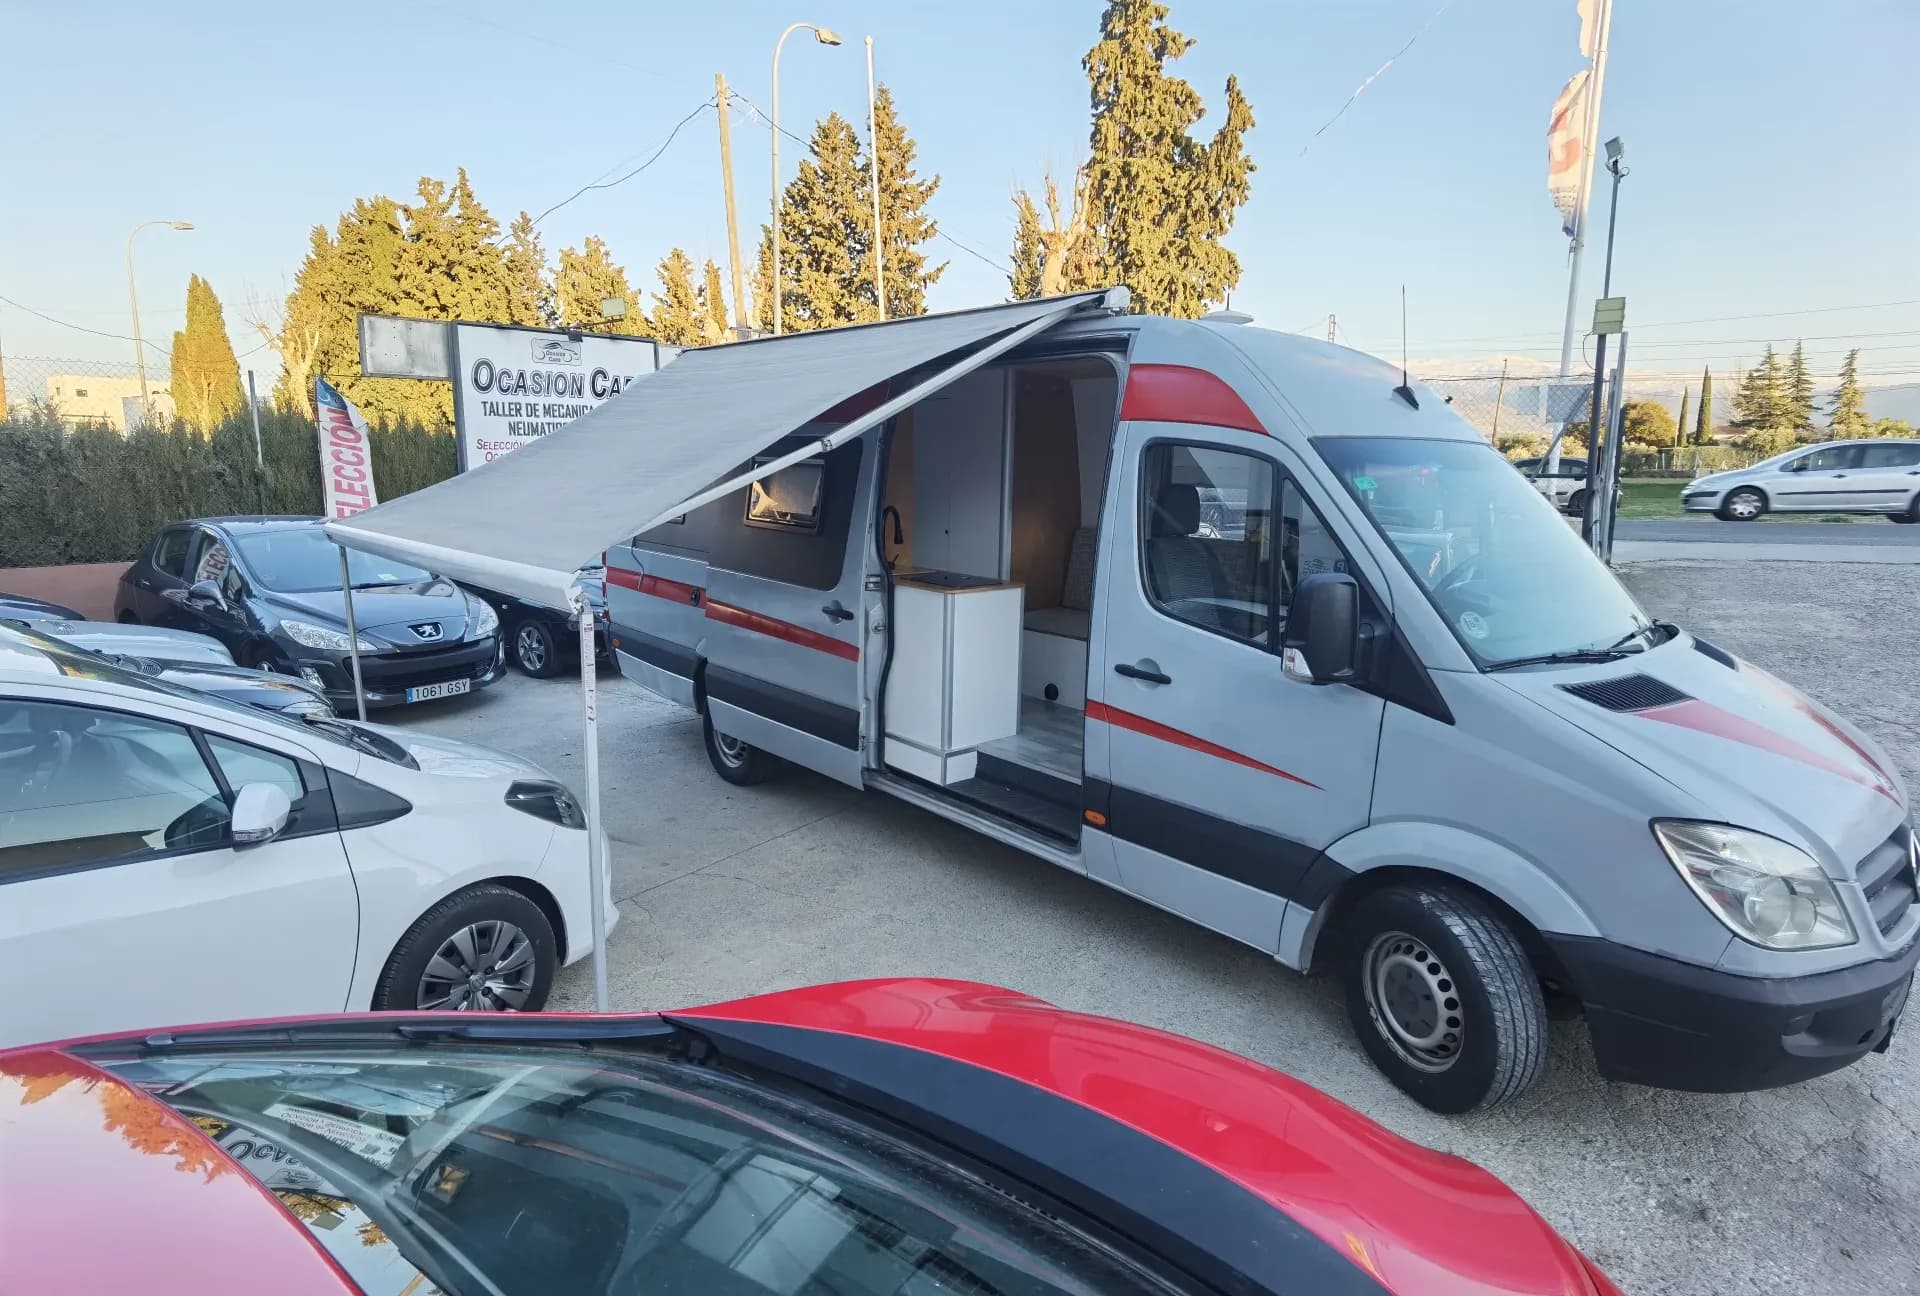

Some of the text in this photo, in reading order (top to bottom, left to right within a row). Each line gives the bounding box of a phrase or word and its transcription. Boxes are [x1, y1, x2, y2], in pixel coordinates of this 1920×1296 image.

[590, 367, 635, 400] CA
[481, 401, 593, 418] TALLER DE MECANIC
[508, 421, 567, 437] NEUMATI
[415, 681, 468, 699] 1061 GSY
